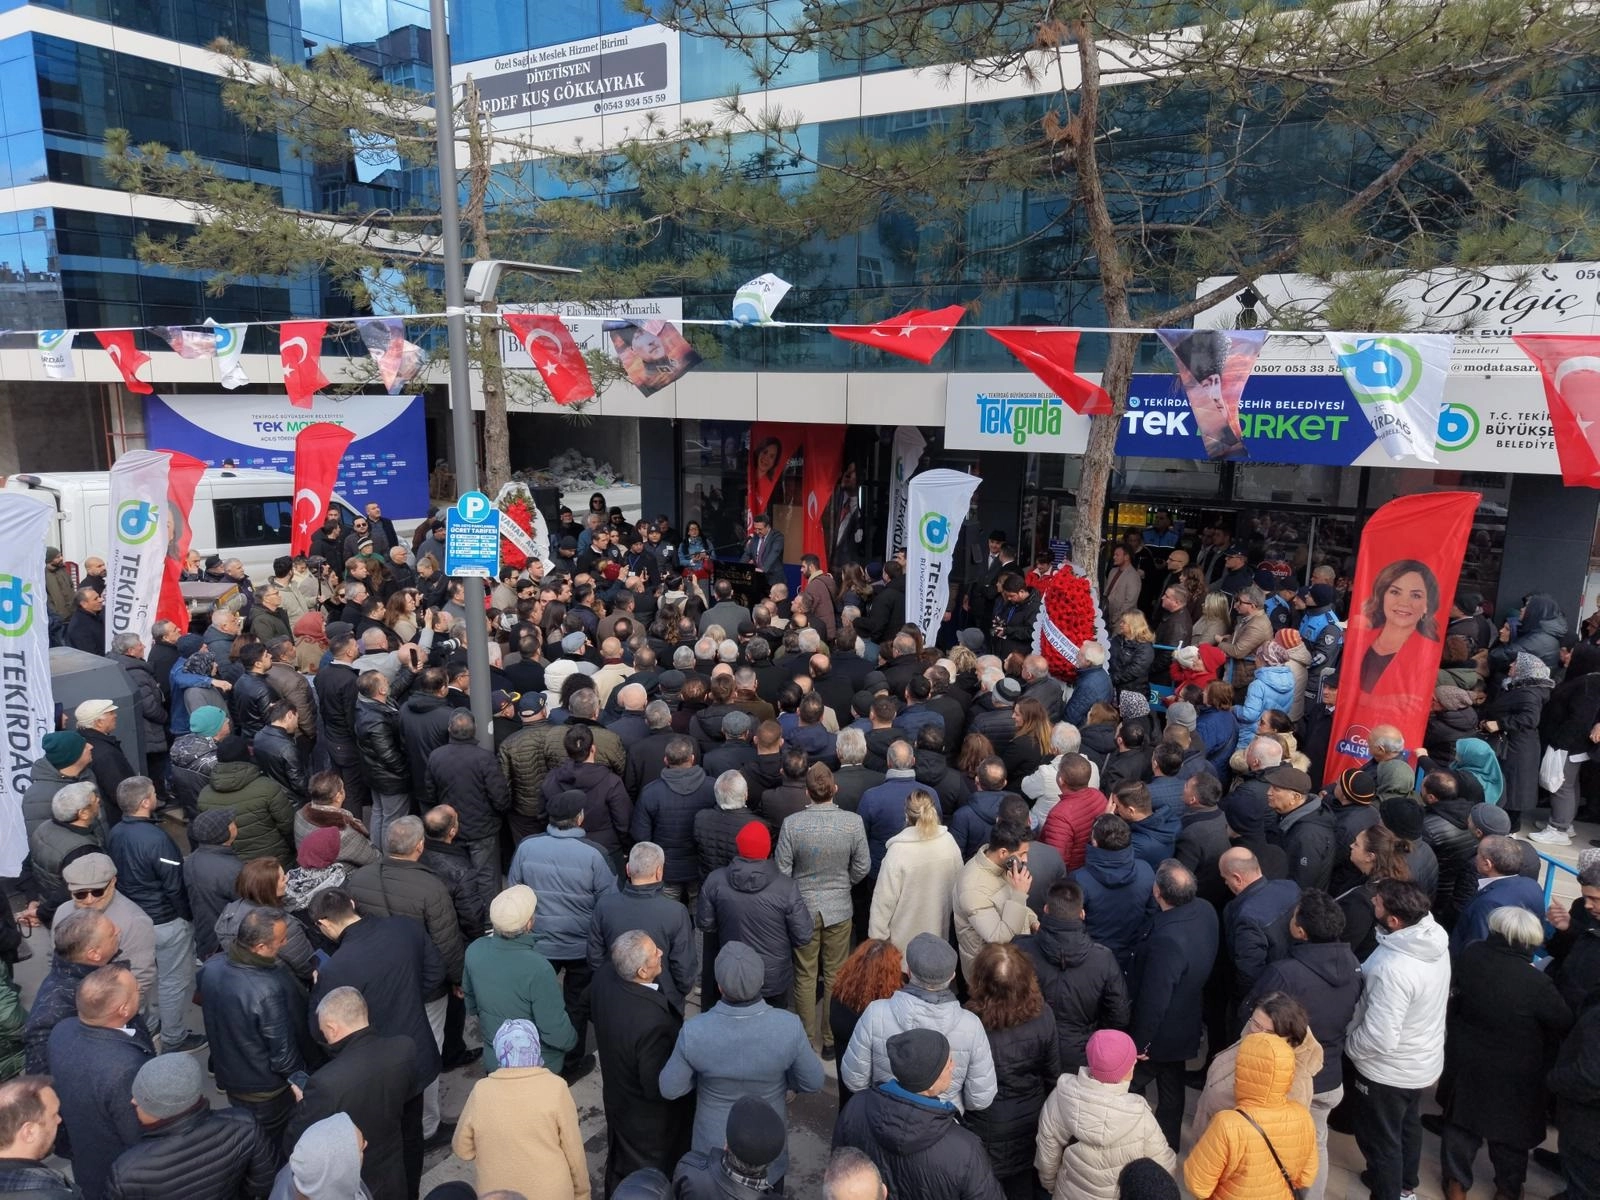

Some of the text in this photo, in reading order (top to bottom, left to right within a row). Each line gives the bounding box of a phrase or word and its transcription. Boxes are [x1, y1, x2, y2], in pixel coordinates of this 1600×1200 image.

[495, 35, 628, 71] Özel Sağlık Meslek Hizmet Birimi
[526, 61, 591, 85] DİYETİSYEN
[522, 89, 549, 107] KUŞ
[553, 71, 645, 101] GÖKKAYRAK
[603, 93, 667, 111] 0543 934 55 59
[1421, 275, 1583, 325] Bilgiç
[1144, 397, 1192, 407] TEKİRDA
[1275, 400, 1345, 411] BELEDİYESİ
[1489, 411, 1513, 421] T.C.
[466, 496, 484, 518] P
[450, 526, 471, 534] ÜCRET
[472, 527, 498, 535] TARİFESİ
[500, 514, 525, 538] VAHAP
[112, 554, 142, 635] TEKİRD
